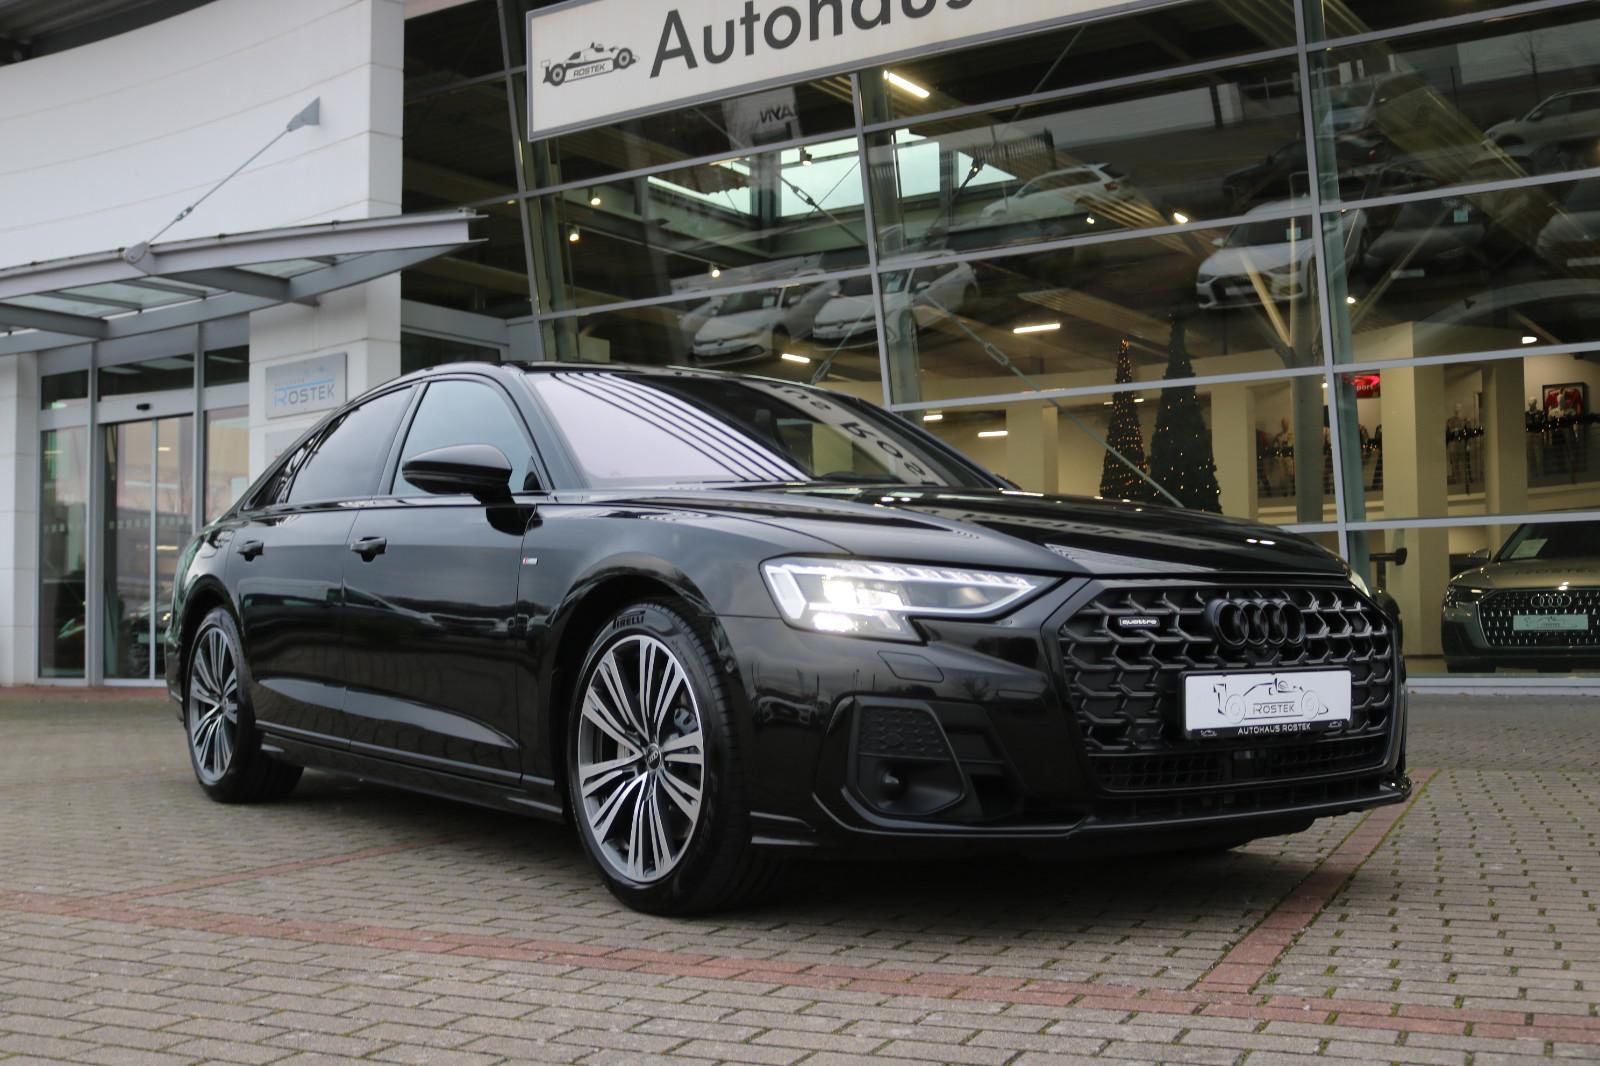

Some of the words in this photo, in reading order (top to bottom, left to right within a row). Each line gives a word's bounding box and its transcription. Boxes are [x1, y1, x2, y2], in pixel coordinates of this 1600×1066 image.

[649, 0, 973, 79] Autoha
[573, 63, 606, 78] ROSTEK
[272, 384, 336, 408] ROSTEK
[612, 610, 646, 630] PIRELLI
[1122, 618, 1158, 626] quattro
[1253, 703, 1295, 714] ROSTEK
[1238, 723, 1281, 735] AUTOHAUS
[1282, 722, 1311, 733] ROSTEK
